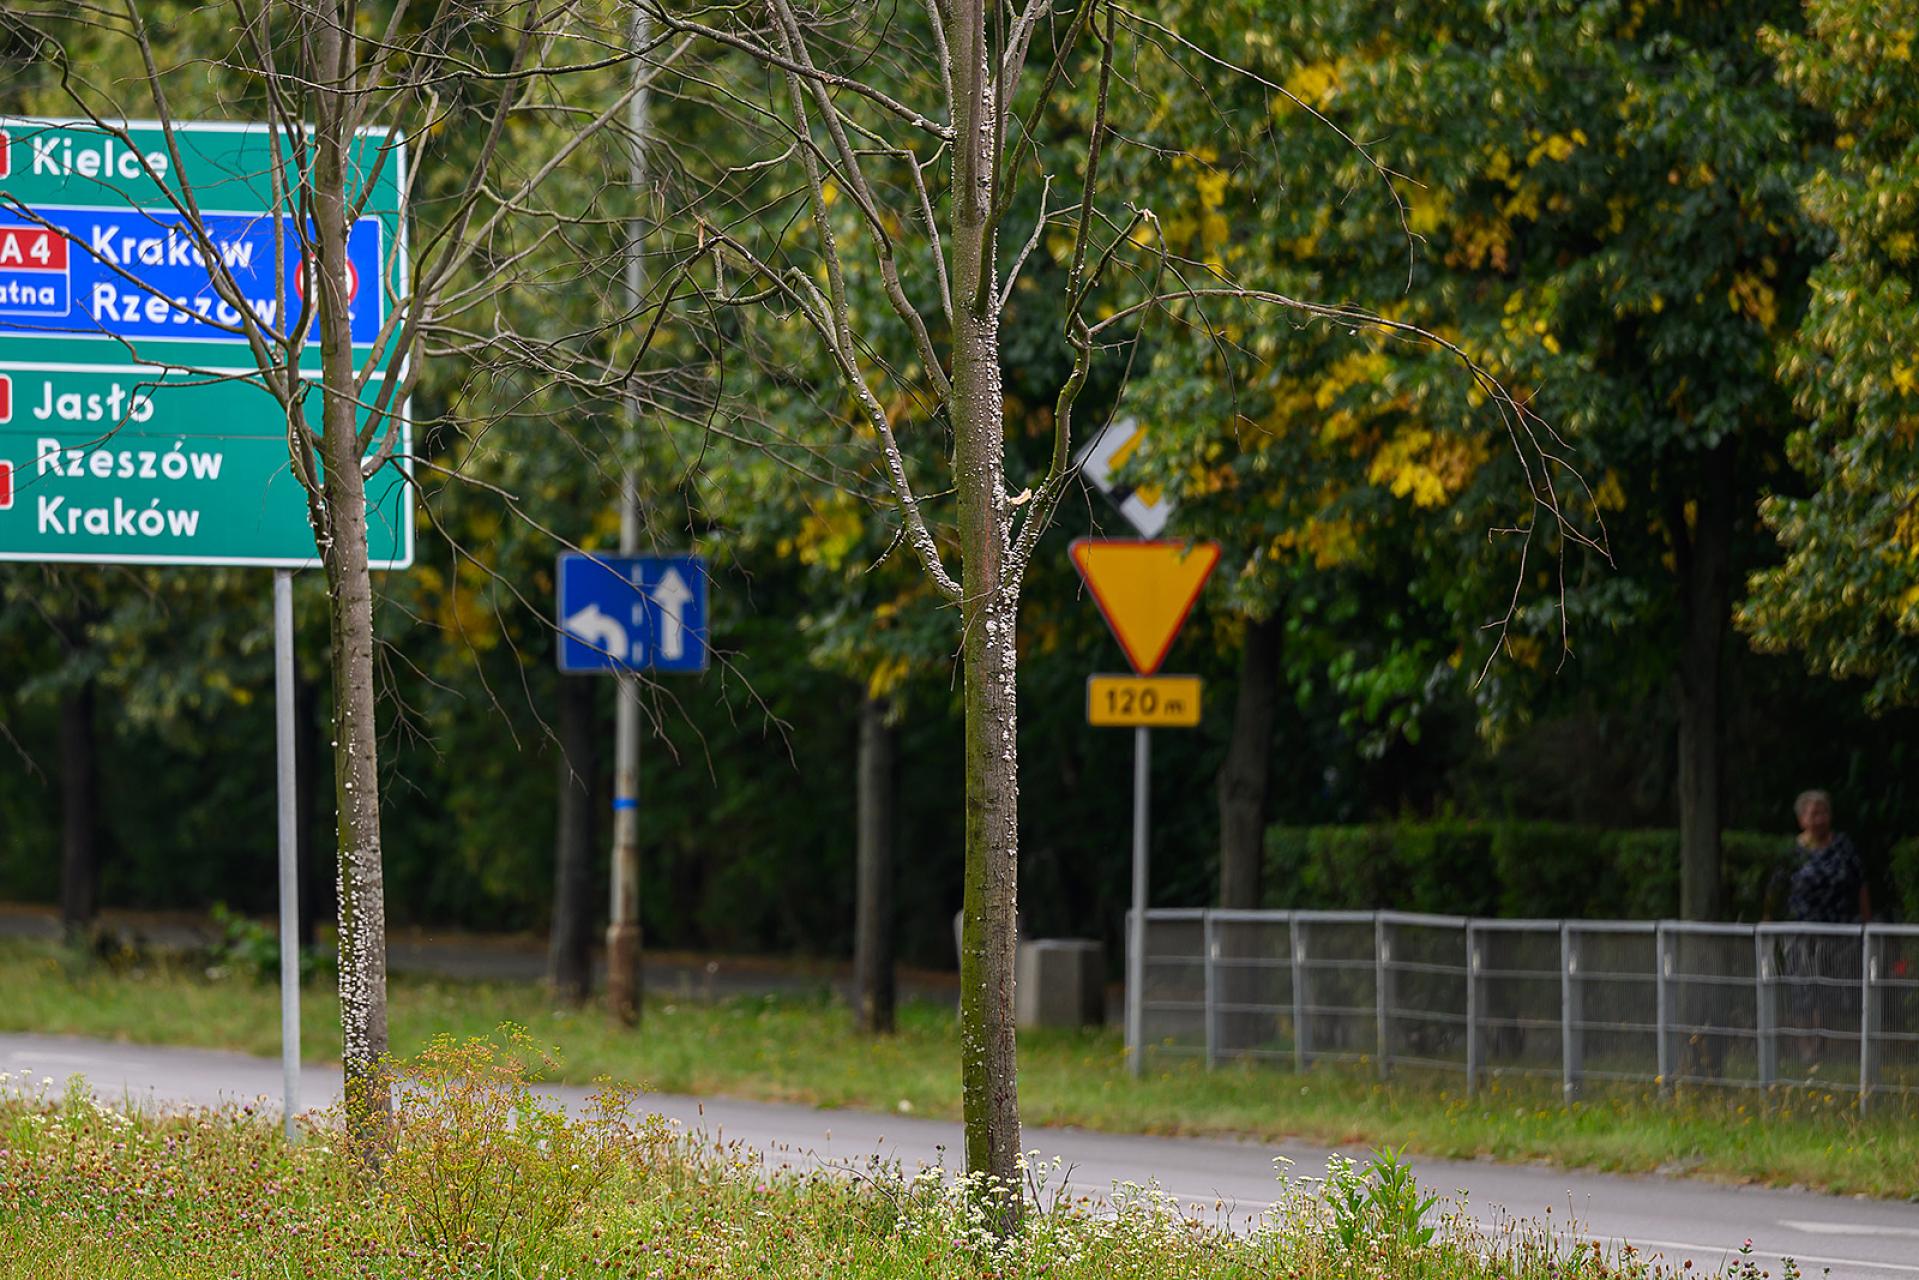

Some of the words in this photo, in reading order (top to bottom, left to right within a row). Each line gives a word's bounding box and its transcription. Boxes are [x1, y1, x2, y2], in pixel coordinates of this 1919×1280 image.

[33, 136, 169, 180] Kielce
[32, 380, 155, 423] Jasło
[36, 437, 223, 480] Rzeszów
[37, 495, 200, 537] Kraków
[1105, 688, 1159, 716] 120
[1164, 701, 1186, 715] m
